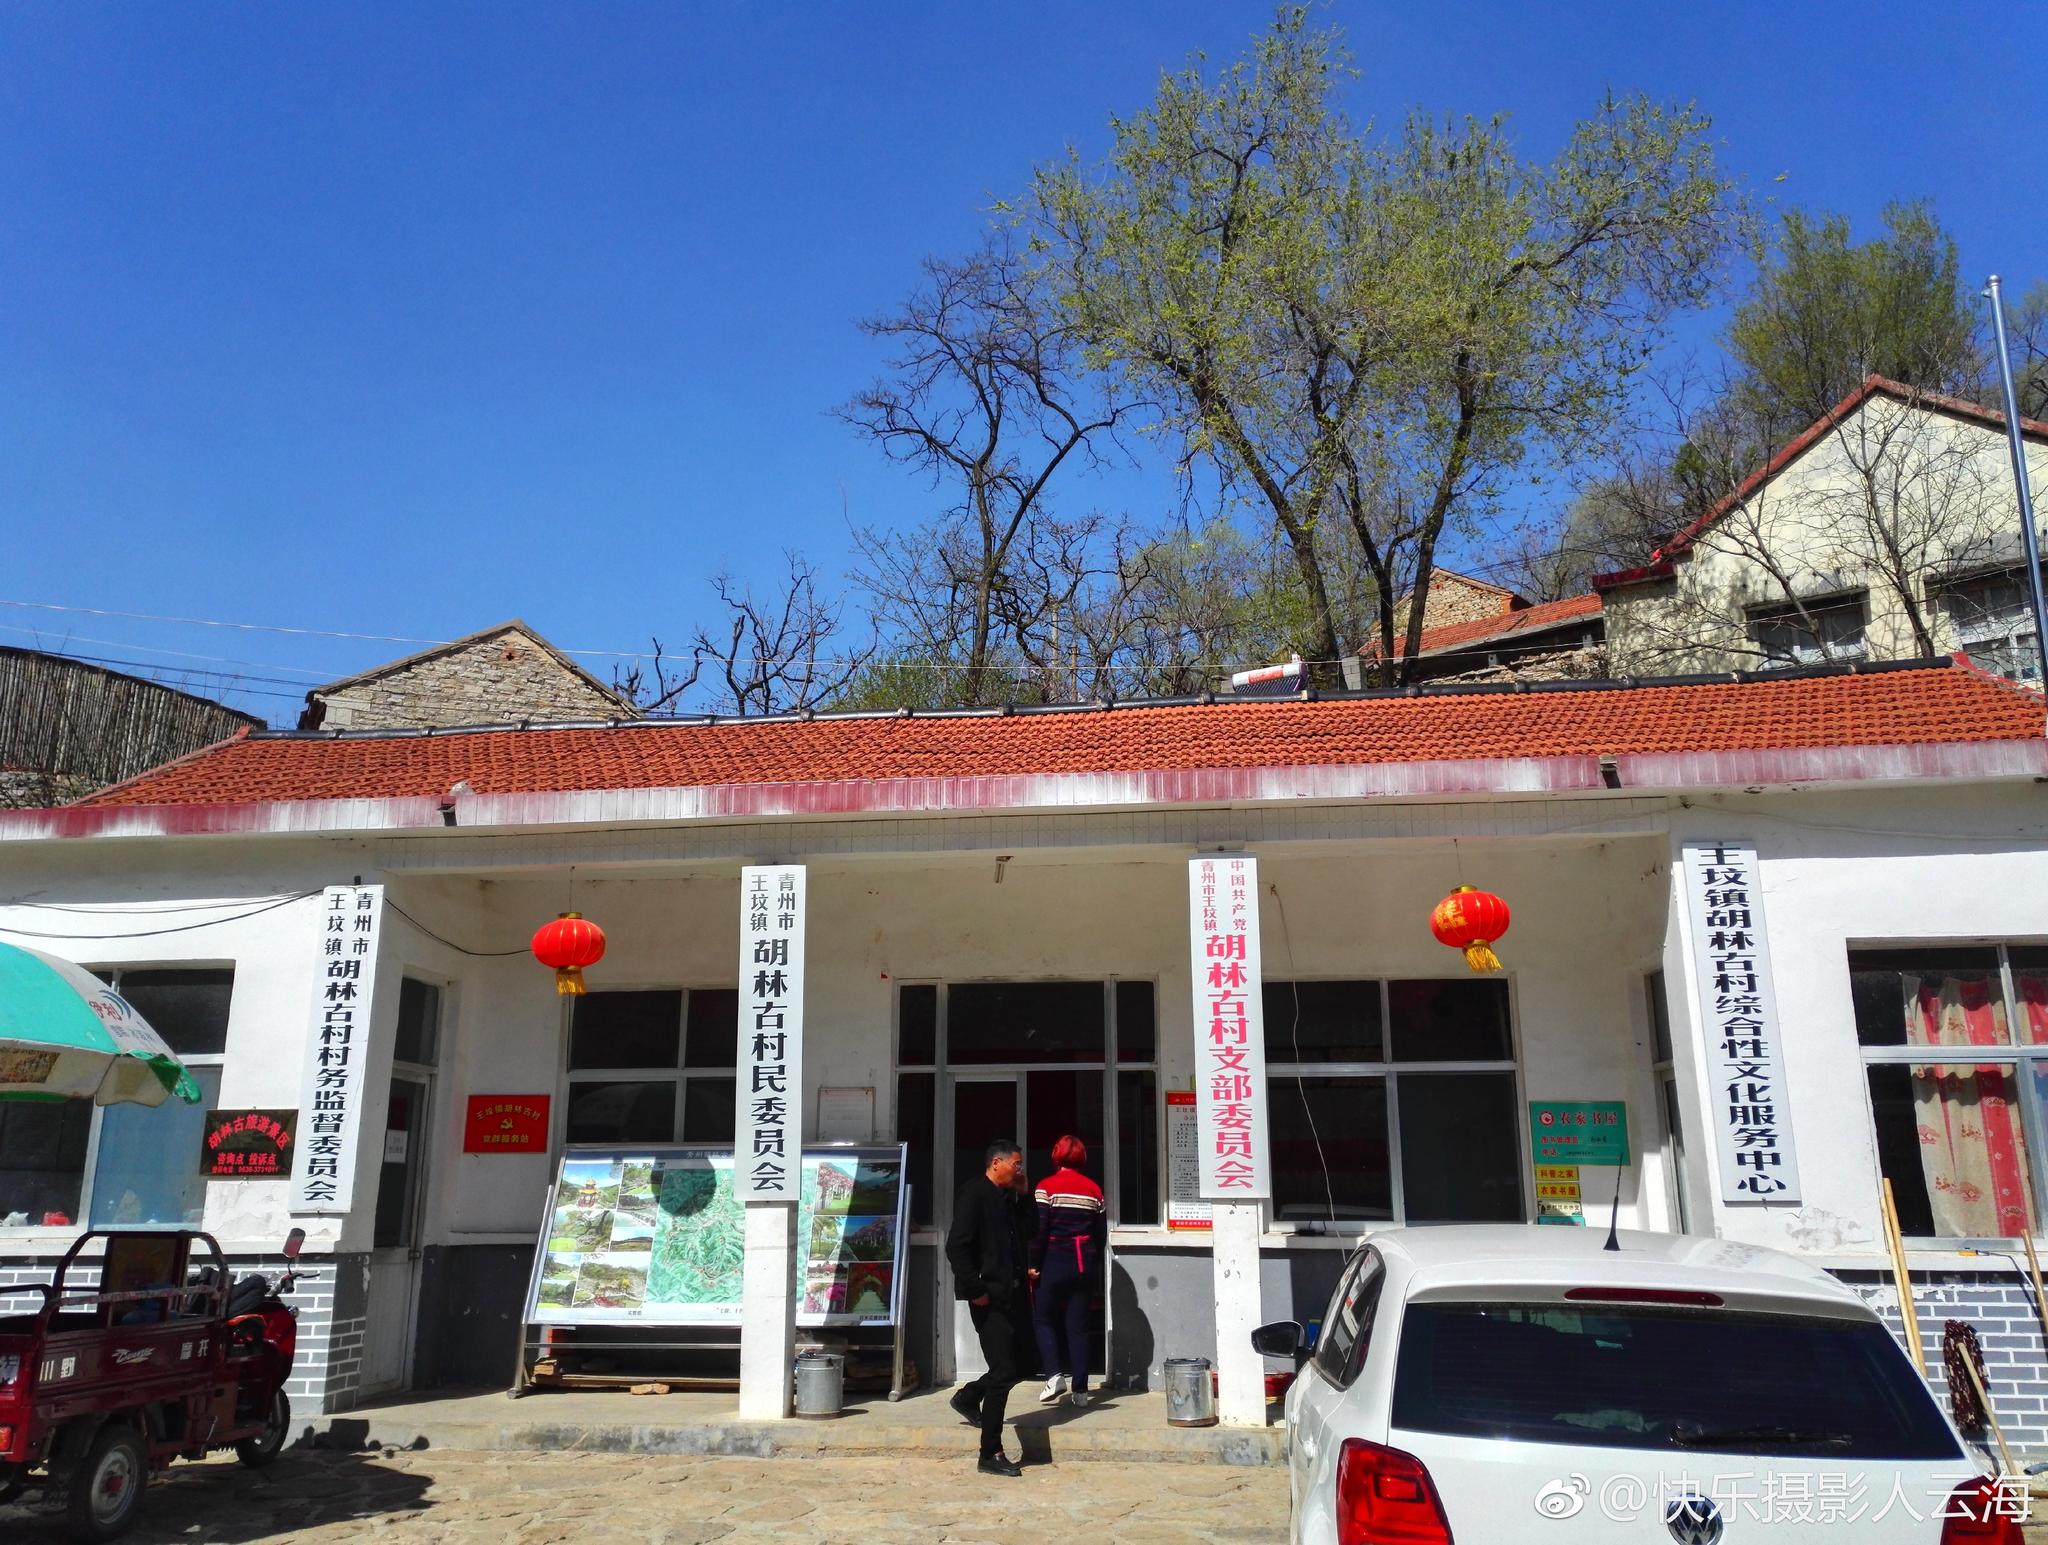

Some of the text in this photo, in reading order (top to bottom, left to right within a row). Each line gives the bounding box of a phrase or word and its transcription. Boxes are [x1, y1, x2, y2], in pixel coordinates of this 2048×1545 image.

[324, 893, 347, 956] 王坟镇
[352, 893, 373, 956] 青州市
[750, 874, 769, 932] 王坟镇
[777, 873, 796, 931] 青州市
[1201, 860, 1217, 932] 青州市王坟镇
[1230, 860, 1248, 931] 中国共产党
[1697, 847, 1786, 1195] 王坟镇胡林古村综合性文化服务中心
[303, 959, 361, 1202] 胡林古村村务监督委员会
[751, 938, 789, 1192] 胡林古村民委员会
[1205, 933, 1255, 1190] 胡林古村支部委员会
[208, 1113, 290, 1150] 胡林古旅游景区
[1560, 1111, 1617, 1125] 农家书屋
[217, 1152, 277, 1165] 咨询点 投诉点
[1540, 1169, 1574, 1178] 科普之家
[1541, 1186, 1576, 1195] 农家书屋
[179, 1339, 210, 1361] 摩托
